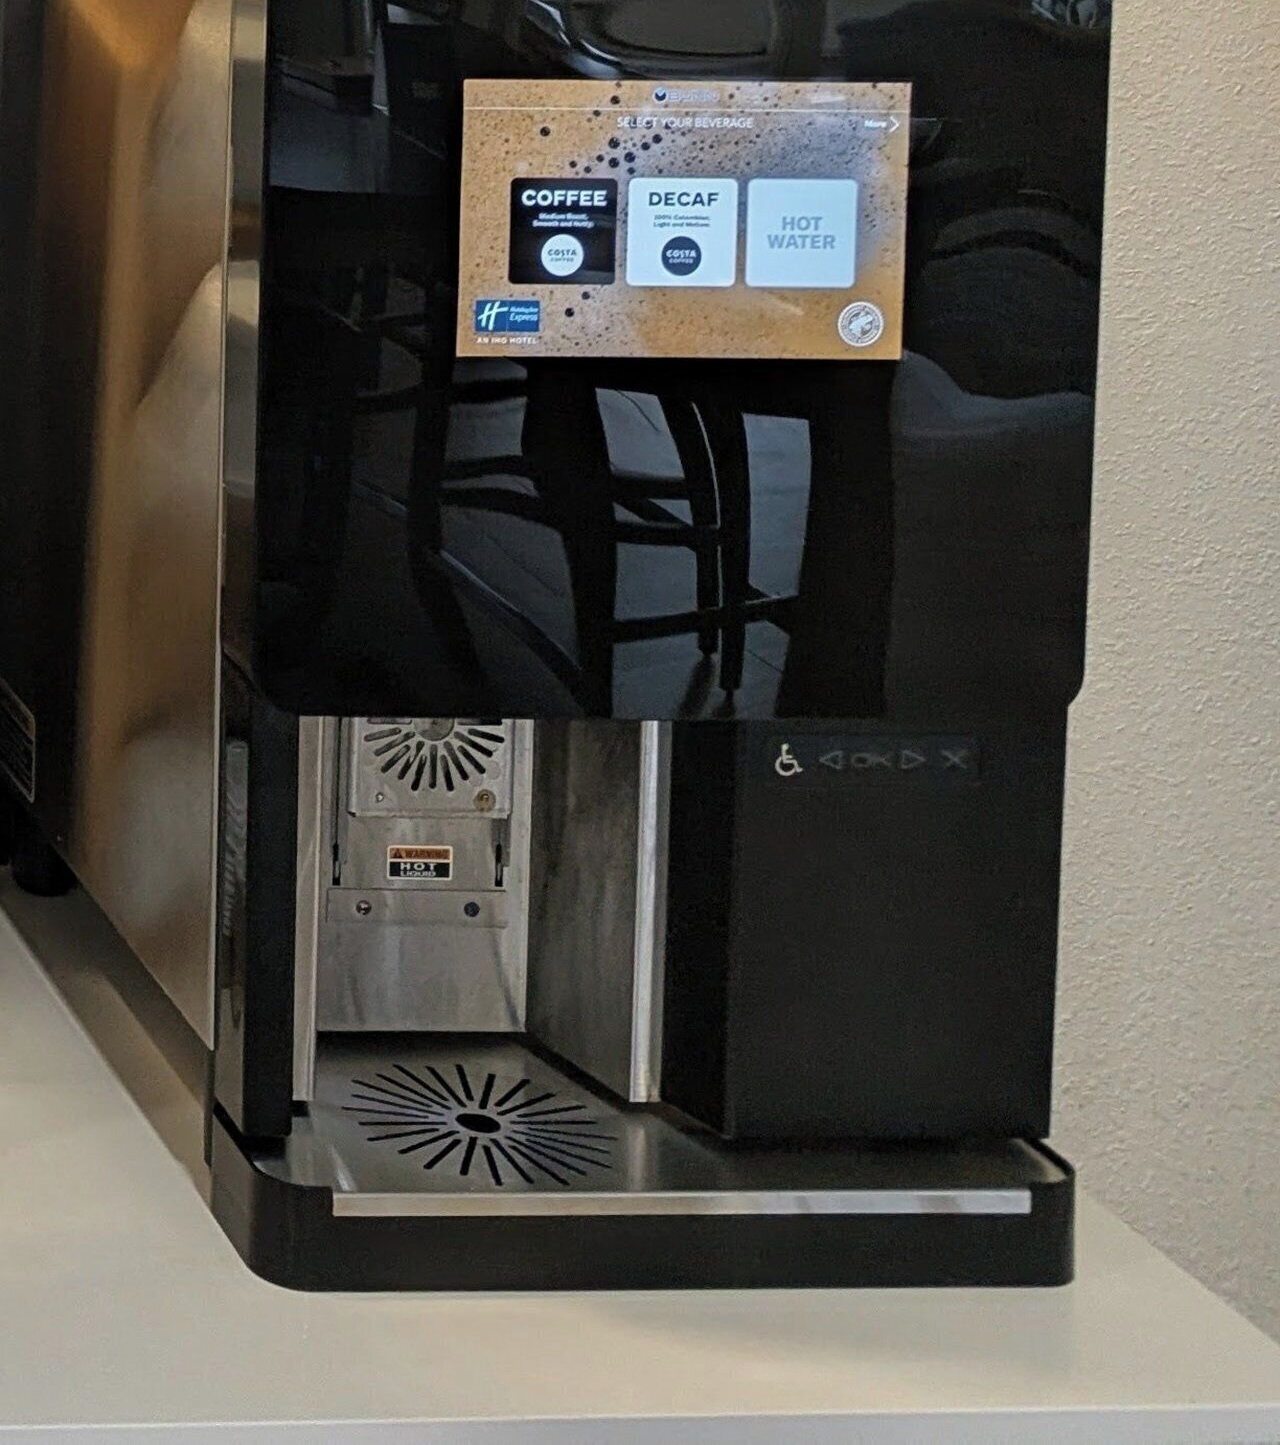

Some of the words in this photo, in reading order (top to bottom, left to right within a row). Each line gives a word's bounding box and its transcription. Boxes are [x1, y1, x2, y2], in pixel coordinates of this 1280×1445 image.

[616, 116, 657, 128] SELECT
[660, 117, 694, 129] YOUR
[695, 117, 754, 129] BEVERAGE
[864, 119, 887, 129] More
[521, 189, 608, 207] COFFEE
[648, 191, 720, 206] DECAF
[538, 212, 566, 220] Medium
[559, 219, 572, 227] and
[781, 216, 823, 231] HOT
[766, 234, 837, 250] WATER
[547, 248, 578, 257] COSTA
[666, 249, 697, 258] COSTA
[509, 313, 539, 322] Express
[509, 336, 538, 344] HOTEL
[400, 862, 437, 871] HOT
